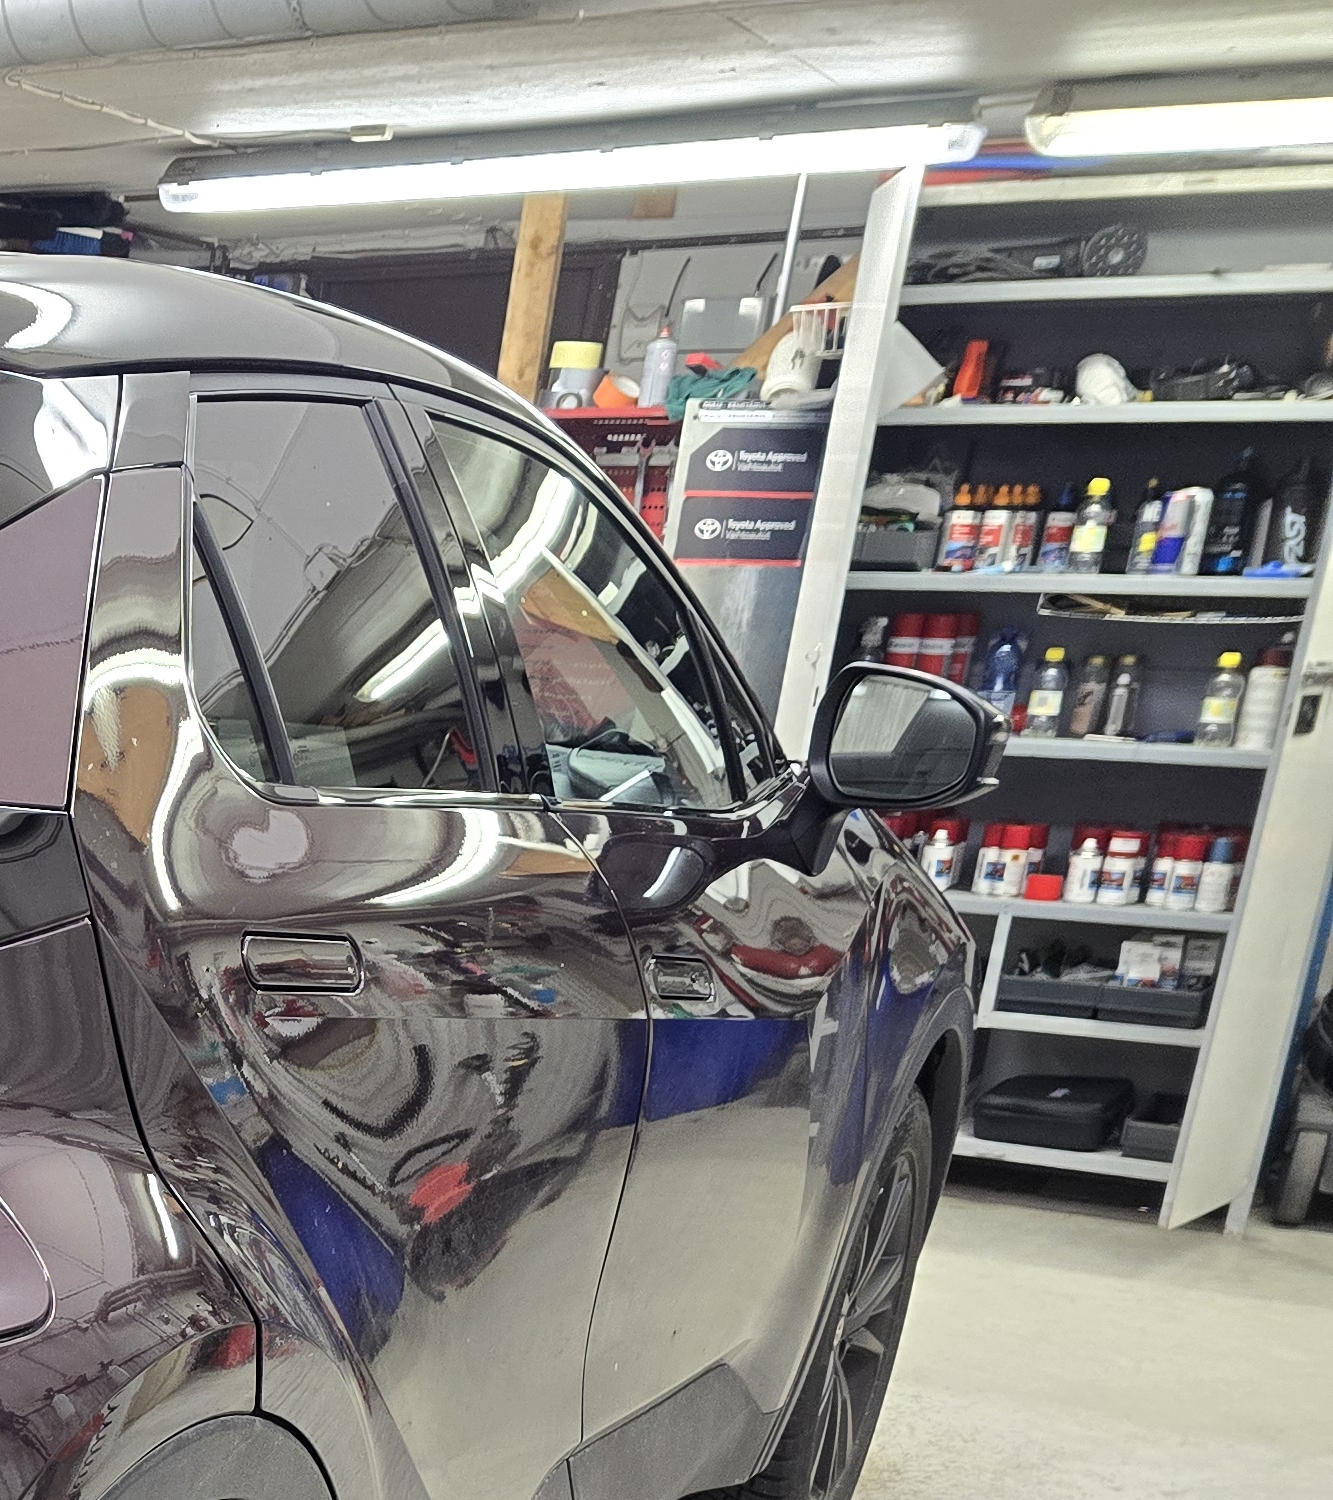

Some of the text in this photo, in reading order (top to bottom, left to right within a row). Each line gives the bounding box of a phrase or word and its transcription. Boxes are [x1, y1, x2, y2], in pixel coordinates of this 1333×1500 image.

[739, 450, 808, 463] Toyota Approved
[727, 518, 797, 531] Toyota Approved
